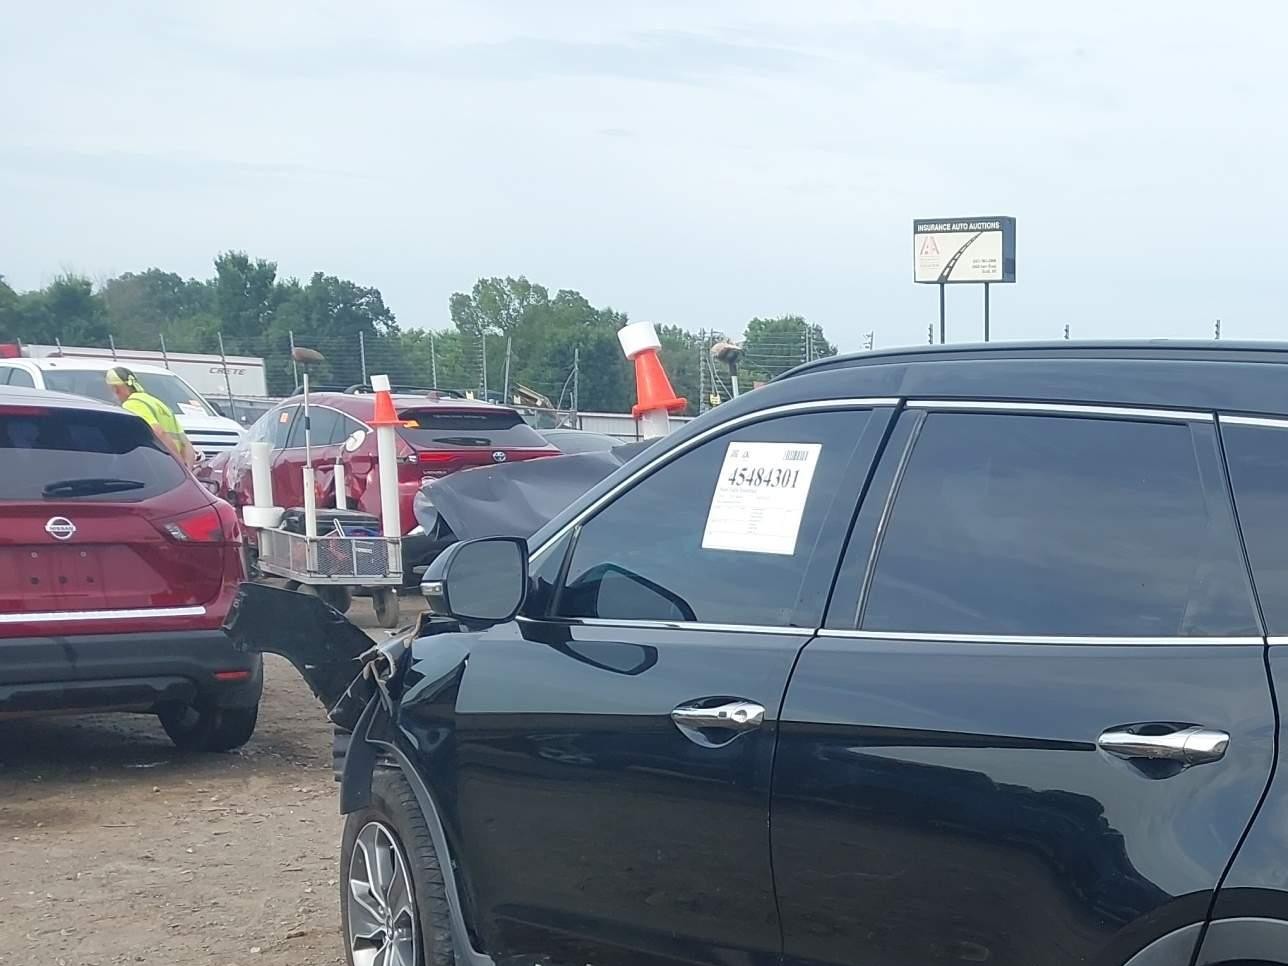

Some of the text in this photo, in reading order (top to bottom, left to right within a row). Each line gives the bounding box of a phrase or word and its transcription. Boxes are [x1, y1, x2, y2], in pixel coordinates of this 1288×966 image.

[917, 221, 1000, 232] INSURANCE AUTO AUCTIONS
[728, 467, 800, 489] 45484301
